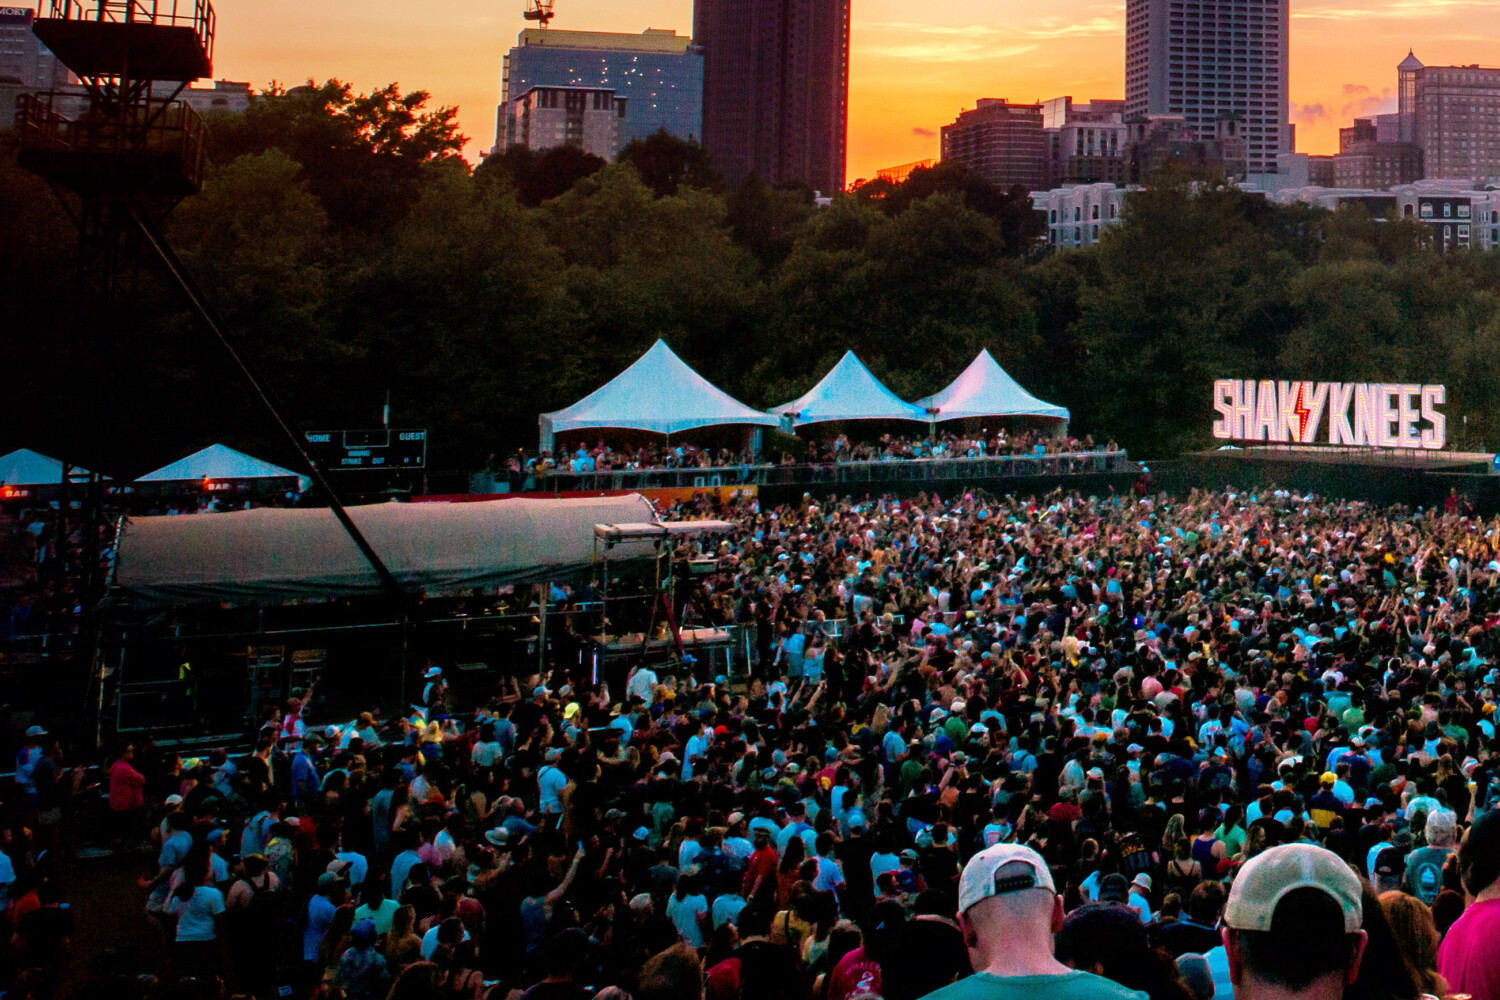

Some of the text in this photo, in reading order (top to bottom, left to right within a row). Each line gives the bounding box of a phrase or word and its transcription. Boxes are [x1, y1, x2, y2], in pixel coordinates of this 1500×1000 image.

[1212, 378, 1446, 450] SHAKY KNEES
[307, 432, 425, 443] HOME GUEST
[208, 483, 230, 491] BAR
[5, 489, 30, 498] BAR
